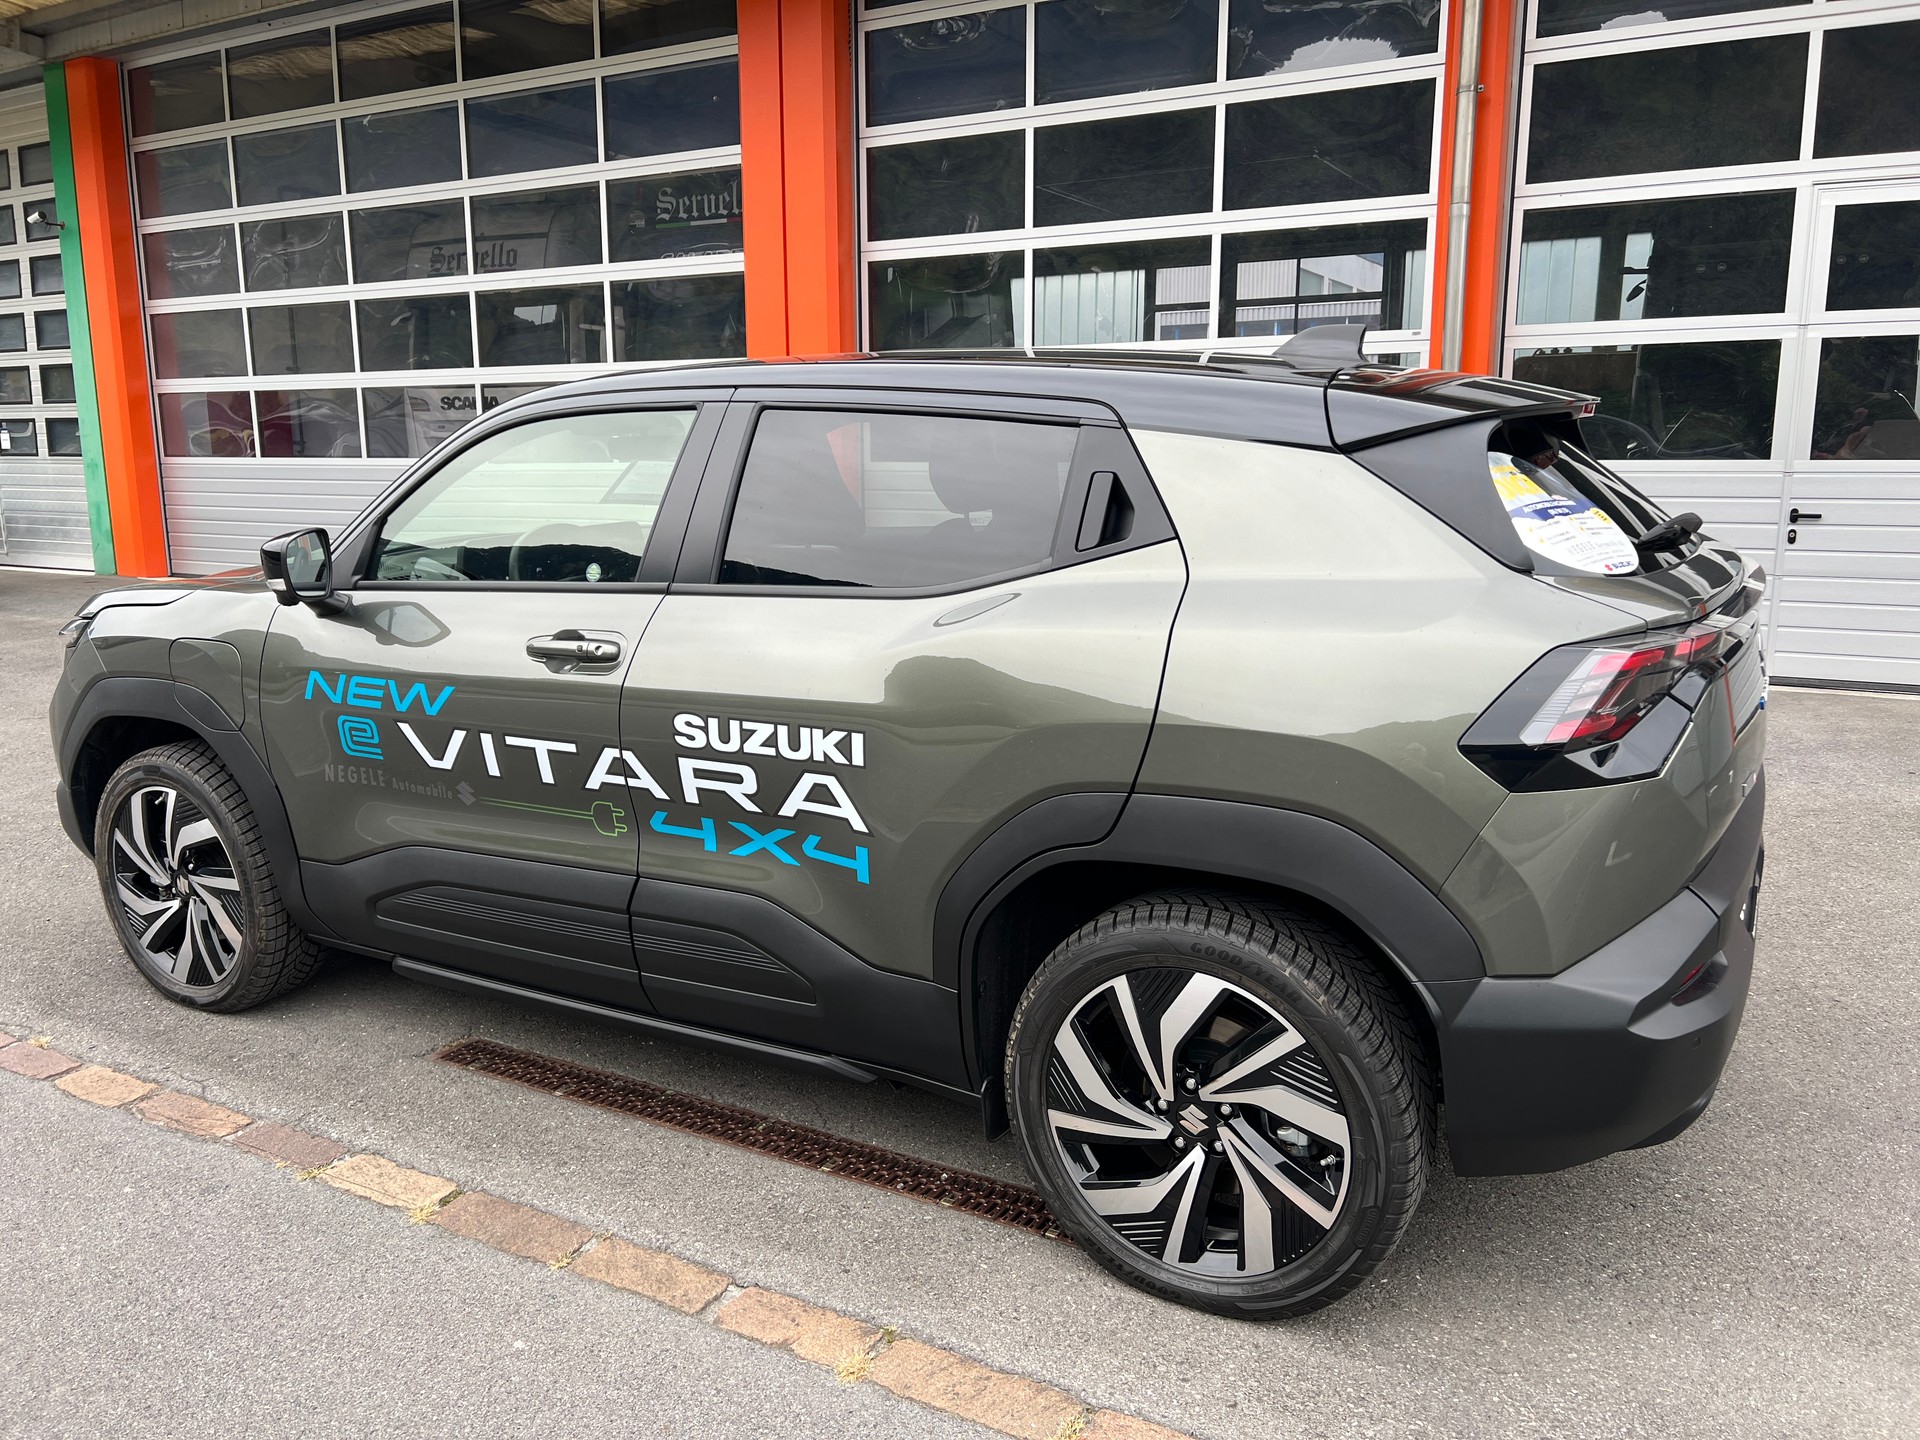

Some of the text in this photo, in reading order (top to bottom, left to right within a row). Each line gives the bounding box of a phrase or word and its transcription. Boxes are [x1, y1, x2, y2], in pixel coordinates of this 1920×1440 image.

[655, 180, 743, 221] Servel
[304, 670, 455, 717] NEW
[674, 713, 865, 767] SUZUKI
[324, 763, 453, 800] NEGELE Automobile
[397, 722, 870, 833] VITARA
[1190, 941, 1303, 1004] GOODYEAR
